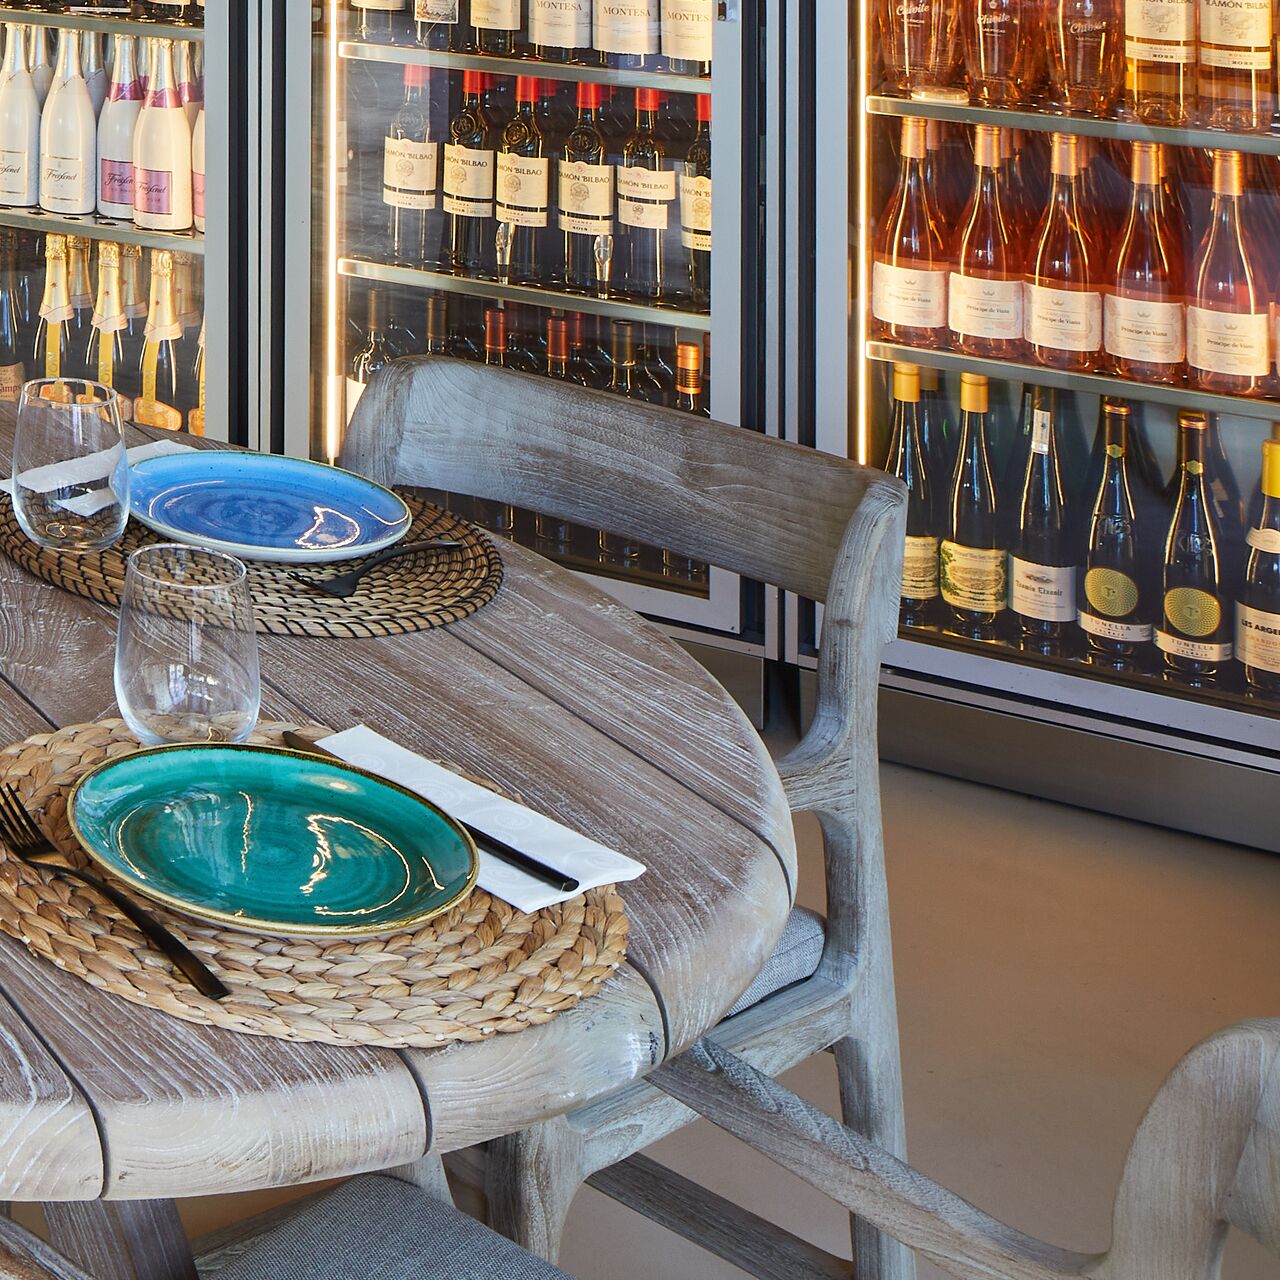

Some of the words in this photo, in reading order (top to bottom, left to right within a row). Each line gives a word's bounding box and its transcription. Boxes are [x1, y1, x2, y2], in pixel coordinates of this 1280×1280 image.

[535, 0, 584, 12] MONTESA
[601, 6, 652, 18] MONTESA
[666, 10, 711, 22] MONTES
[406, 152, 434, 161] BILBAO
[460, 159, 488, 168] BILBAO
[44, 167, 78, 183] Freixenet
[513, 167, 543, 177] BILBAO
[105, 170, 134, 188] Freixen
[581, 175, 610, 184] BILBAO
[640, 182, 669, 190] BILBAO
[1089, 617, 1132, 632] TUNELLA
[1241, 618, 1253, 630] LES
[1171, 637, 1215, 652] TUNELLA
